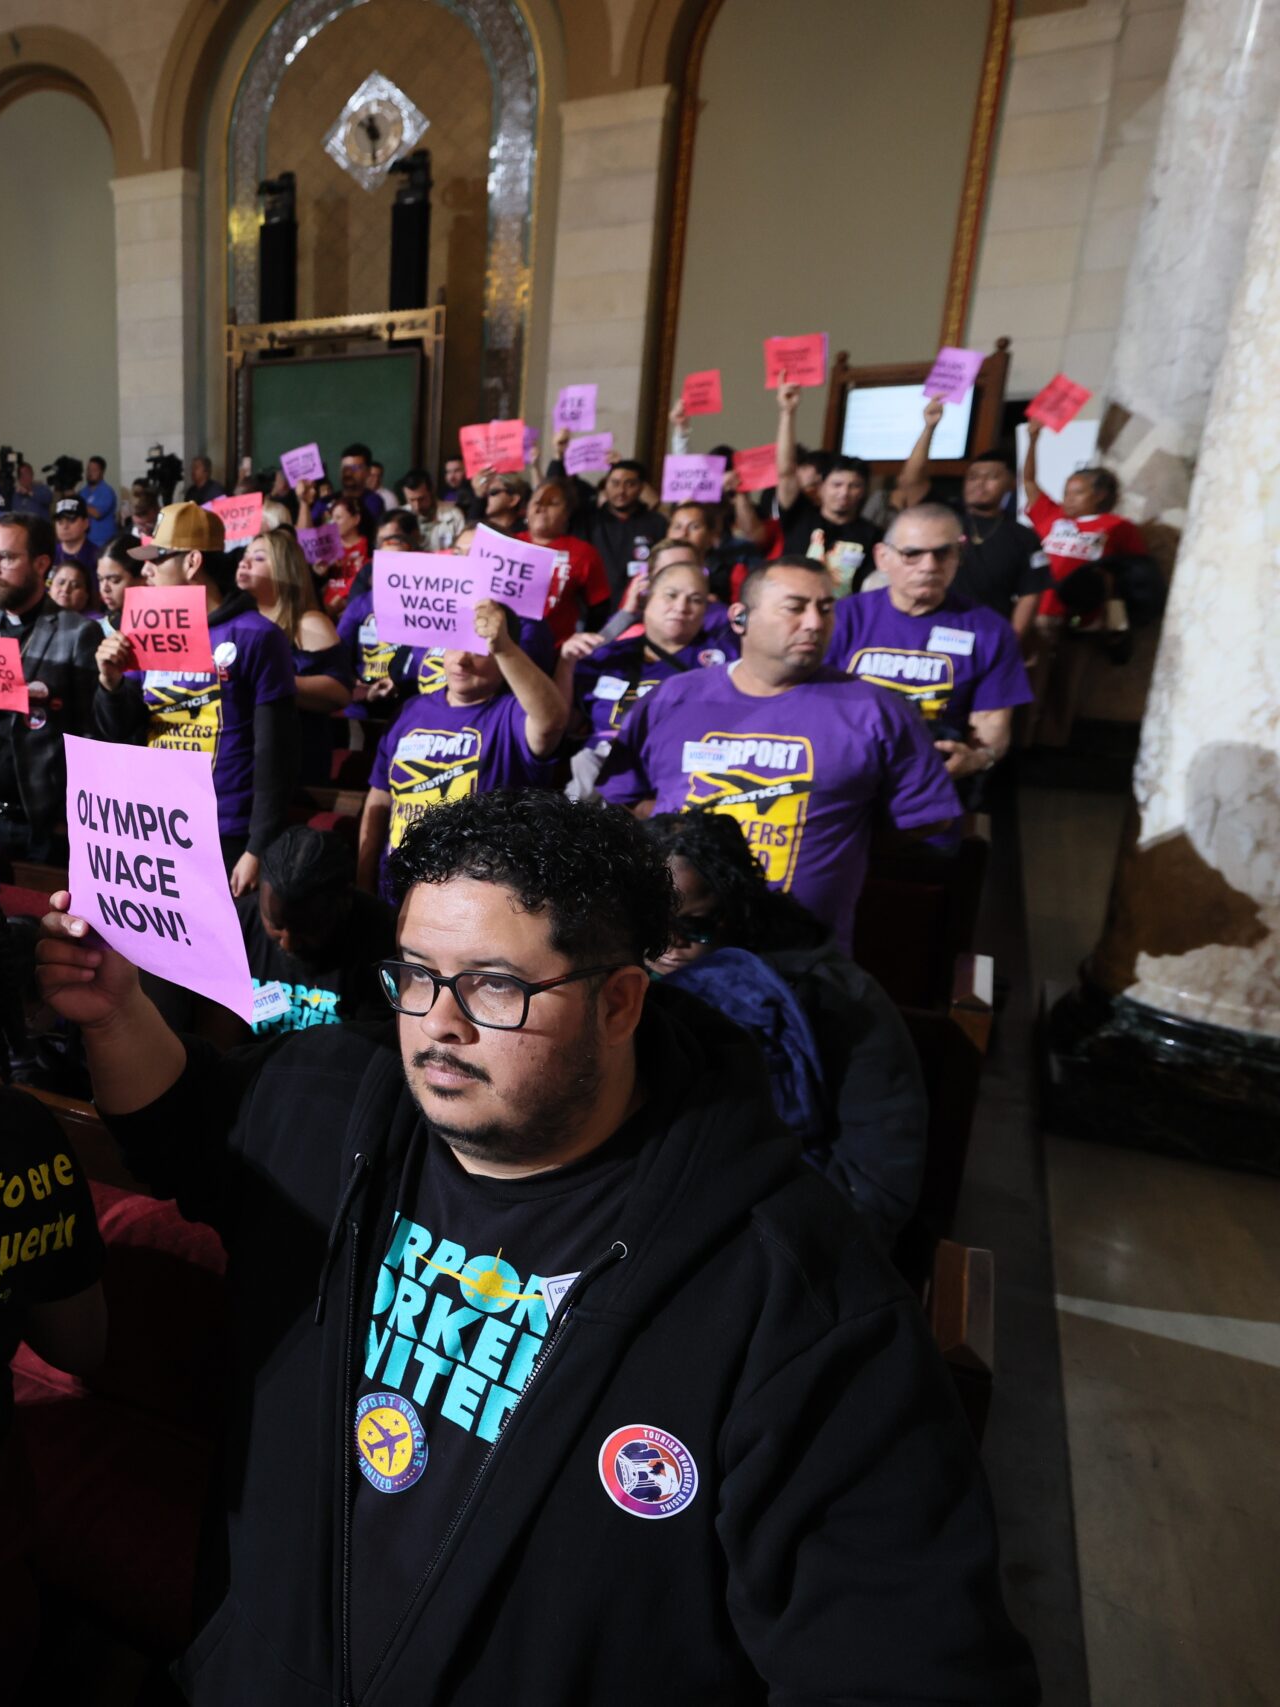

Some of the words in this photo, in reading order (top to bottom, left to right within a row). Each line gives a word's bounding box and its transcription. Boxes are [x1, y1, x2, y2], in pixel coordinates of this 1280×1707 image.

[387, 573, 474, 595] OLYMPIC
[490, 576, 525, 598] ES!
[400, 594, 457, 614] WAGE
[129, 608, 191, 629] VOTE
[404, 614, 457, 632] NOW!
[133, 633, 189, 653] YES!
[857, 652, 946, 682] AIRPORT
[163, 694, 211, 714] JUSTICE
[413, 764, 465, 793] JUSTICE
[718, 782, 794, 806] JUSTICE
[77, 789, 193, 850] OLYMPIC
[86, 842, 181, 899] WAGE
[96, 892, 192, 947] NOW!
[253, 992, 281, 1009] ISITOR
[399, 1400, 425, 1467] WORKERS
[643, 1429, 681, 1454] TOURISM
[359, 1457, 392, 1490] UNITED
[678, 1453, 693, 1494] WORKERS
[659, 1493, 687, 1512] RISING
